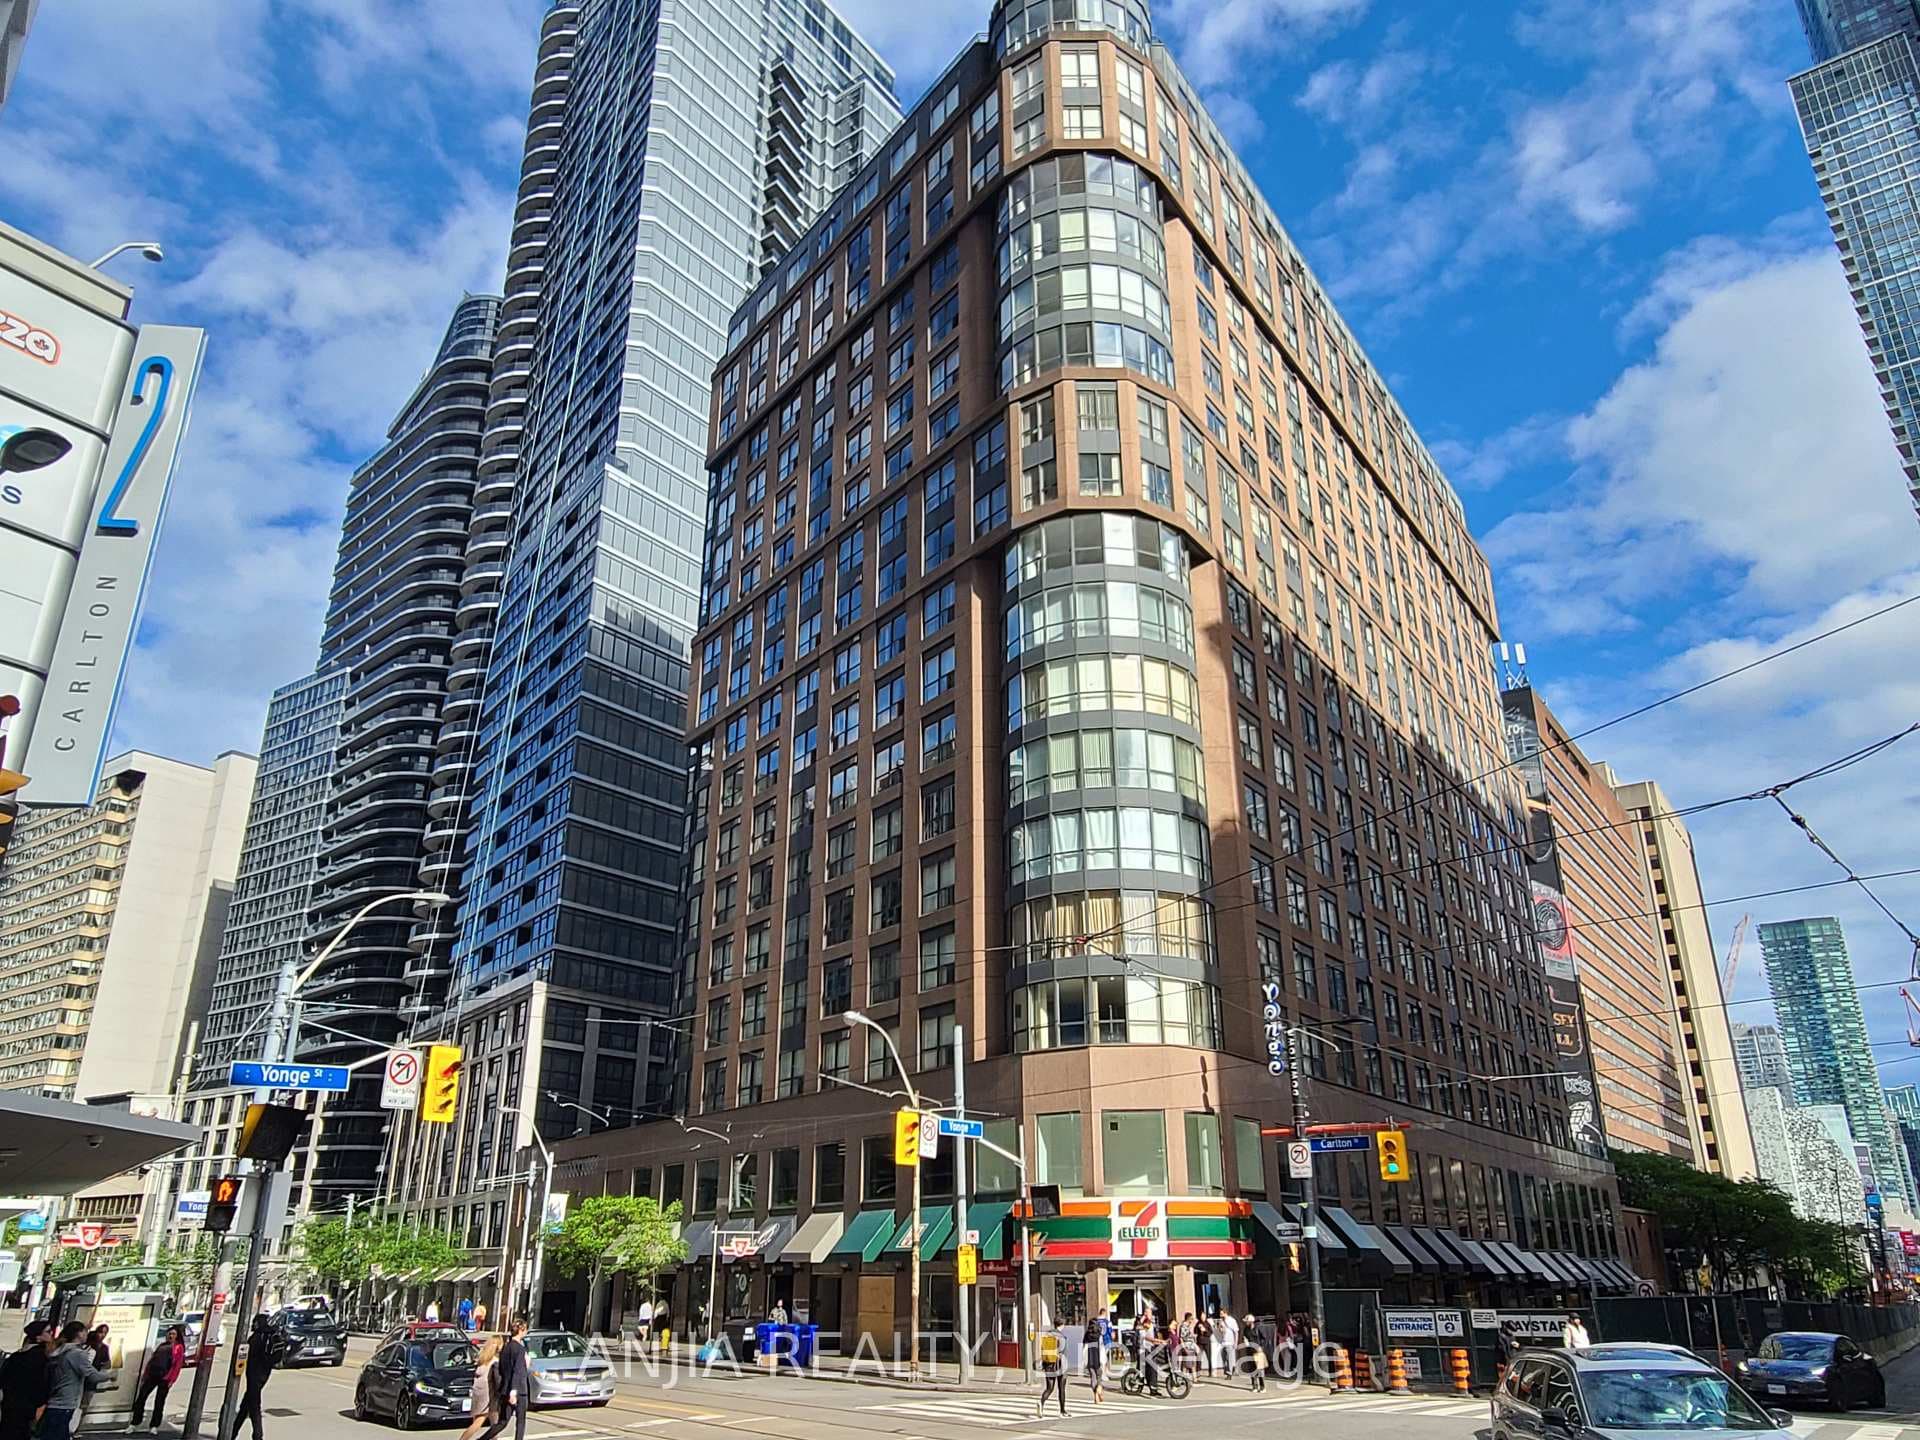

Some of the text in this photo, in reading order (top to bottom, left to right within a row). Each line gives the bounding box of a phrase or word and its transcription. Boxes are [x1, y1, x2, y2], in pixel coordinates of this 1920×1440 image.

[97, 355, 173, 529] 2
[54, 576, 118, 751] CARLTON
[260, 1065, 323, 1087] Yonge St
[1320, 1139, 1352, 1149] Carlton
[188, 1202, 209, 1213] Yong
[1119, 1201, 1158, 1258] 7
[1438, 1313, 1460, 1323] GATE
[1389, 1322, 1434, 1332] ENTRANCE
[1500, 1319, 1567, 1332] AYSTAR
